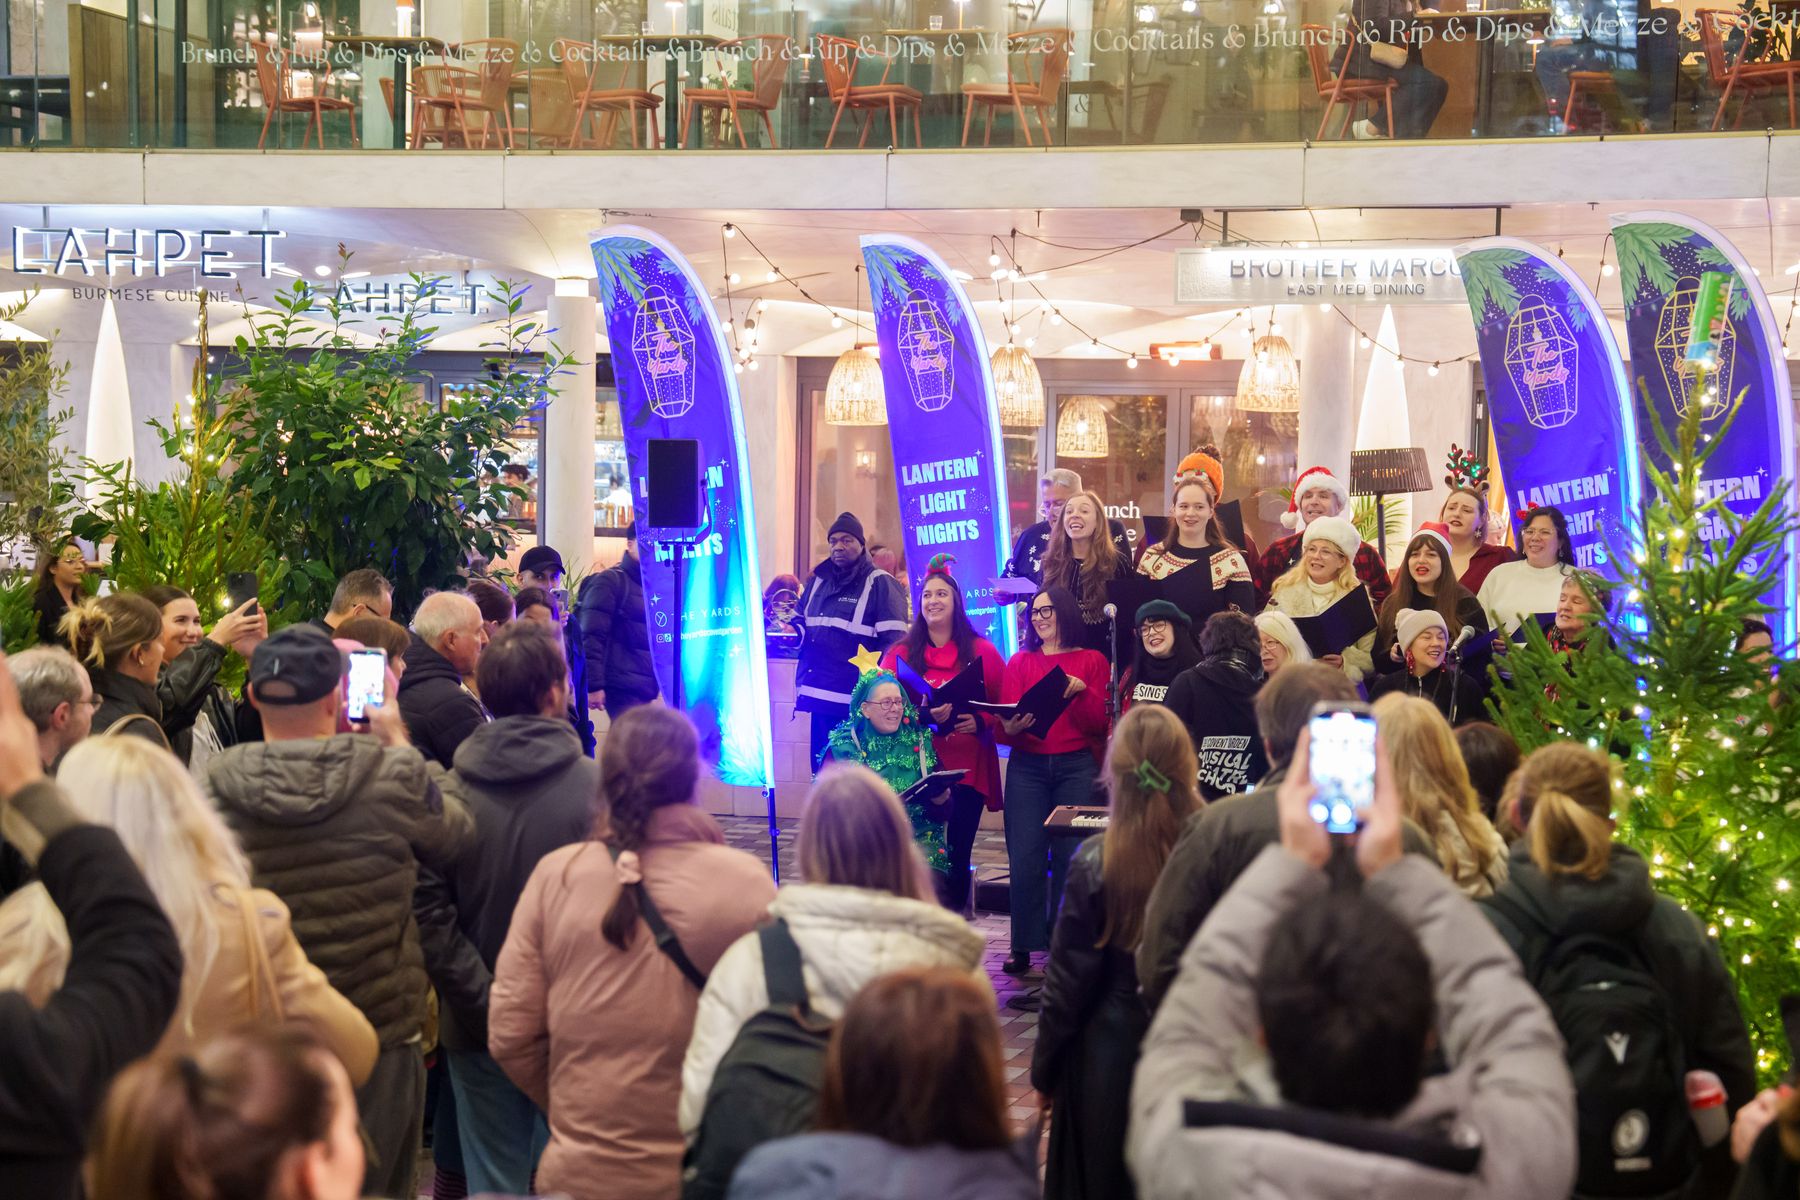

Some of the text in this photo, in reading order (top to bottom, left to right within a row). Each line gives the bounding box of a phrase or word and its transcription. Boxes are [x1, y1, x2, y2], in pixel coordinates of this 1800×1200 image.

[181, 41, 258, 64] Brunch
[265, 40, 286, 64] &
[334, 40, 355, 64] &
[443, 39, 514, 63] Mezze
[520, 40, 542, 63] &
[548, 38, 656, 63] Cocktails
[689, 38, 772, 63] Brunch
[780, 37, 801, 61] &
[856, 35, 878, 59] &
[943, 32, 966, 57] &
[976, 31, 1056, 55] Mezze
[1093, 26, 1214, 52] Cocktails
[1222, 23, 1246, 49] &
[1253, 20, 1347, 48] Brunch
[1356, 19, 1381, 45] &
[1442, 16, 1467, 42] &
[13, 226, 286, 279] LAHPET
[1230, 257, 1463, 278] BROTHER MARCU
[73, 287, 229, 303] BURMESE CUISNE
[1287, 283, 1425, 297] EAST MED DINING
[652, 331, 680, 357] The
[915, 332, 938, 355] The
[1527, 341, 1557, 369] The
[902, 456, 980, 487] LANTERN
[919, 489, 967, 515] LIGHT
[1517, 473, 1610, 511] LANTERN
[1102, 500, 1140, 518] unch
[916, 518, 980, 546] NIGHTS
[1564, 509, 1595, 537] GHT
[965, 587, 994, 599] ARDS
